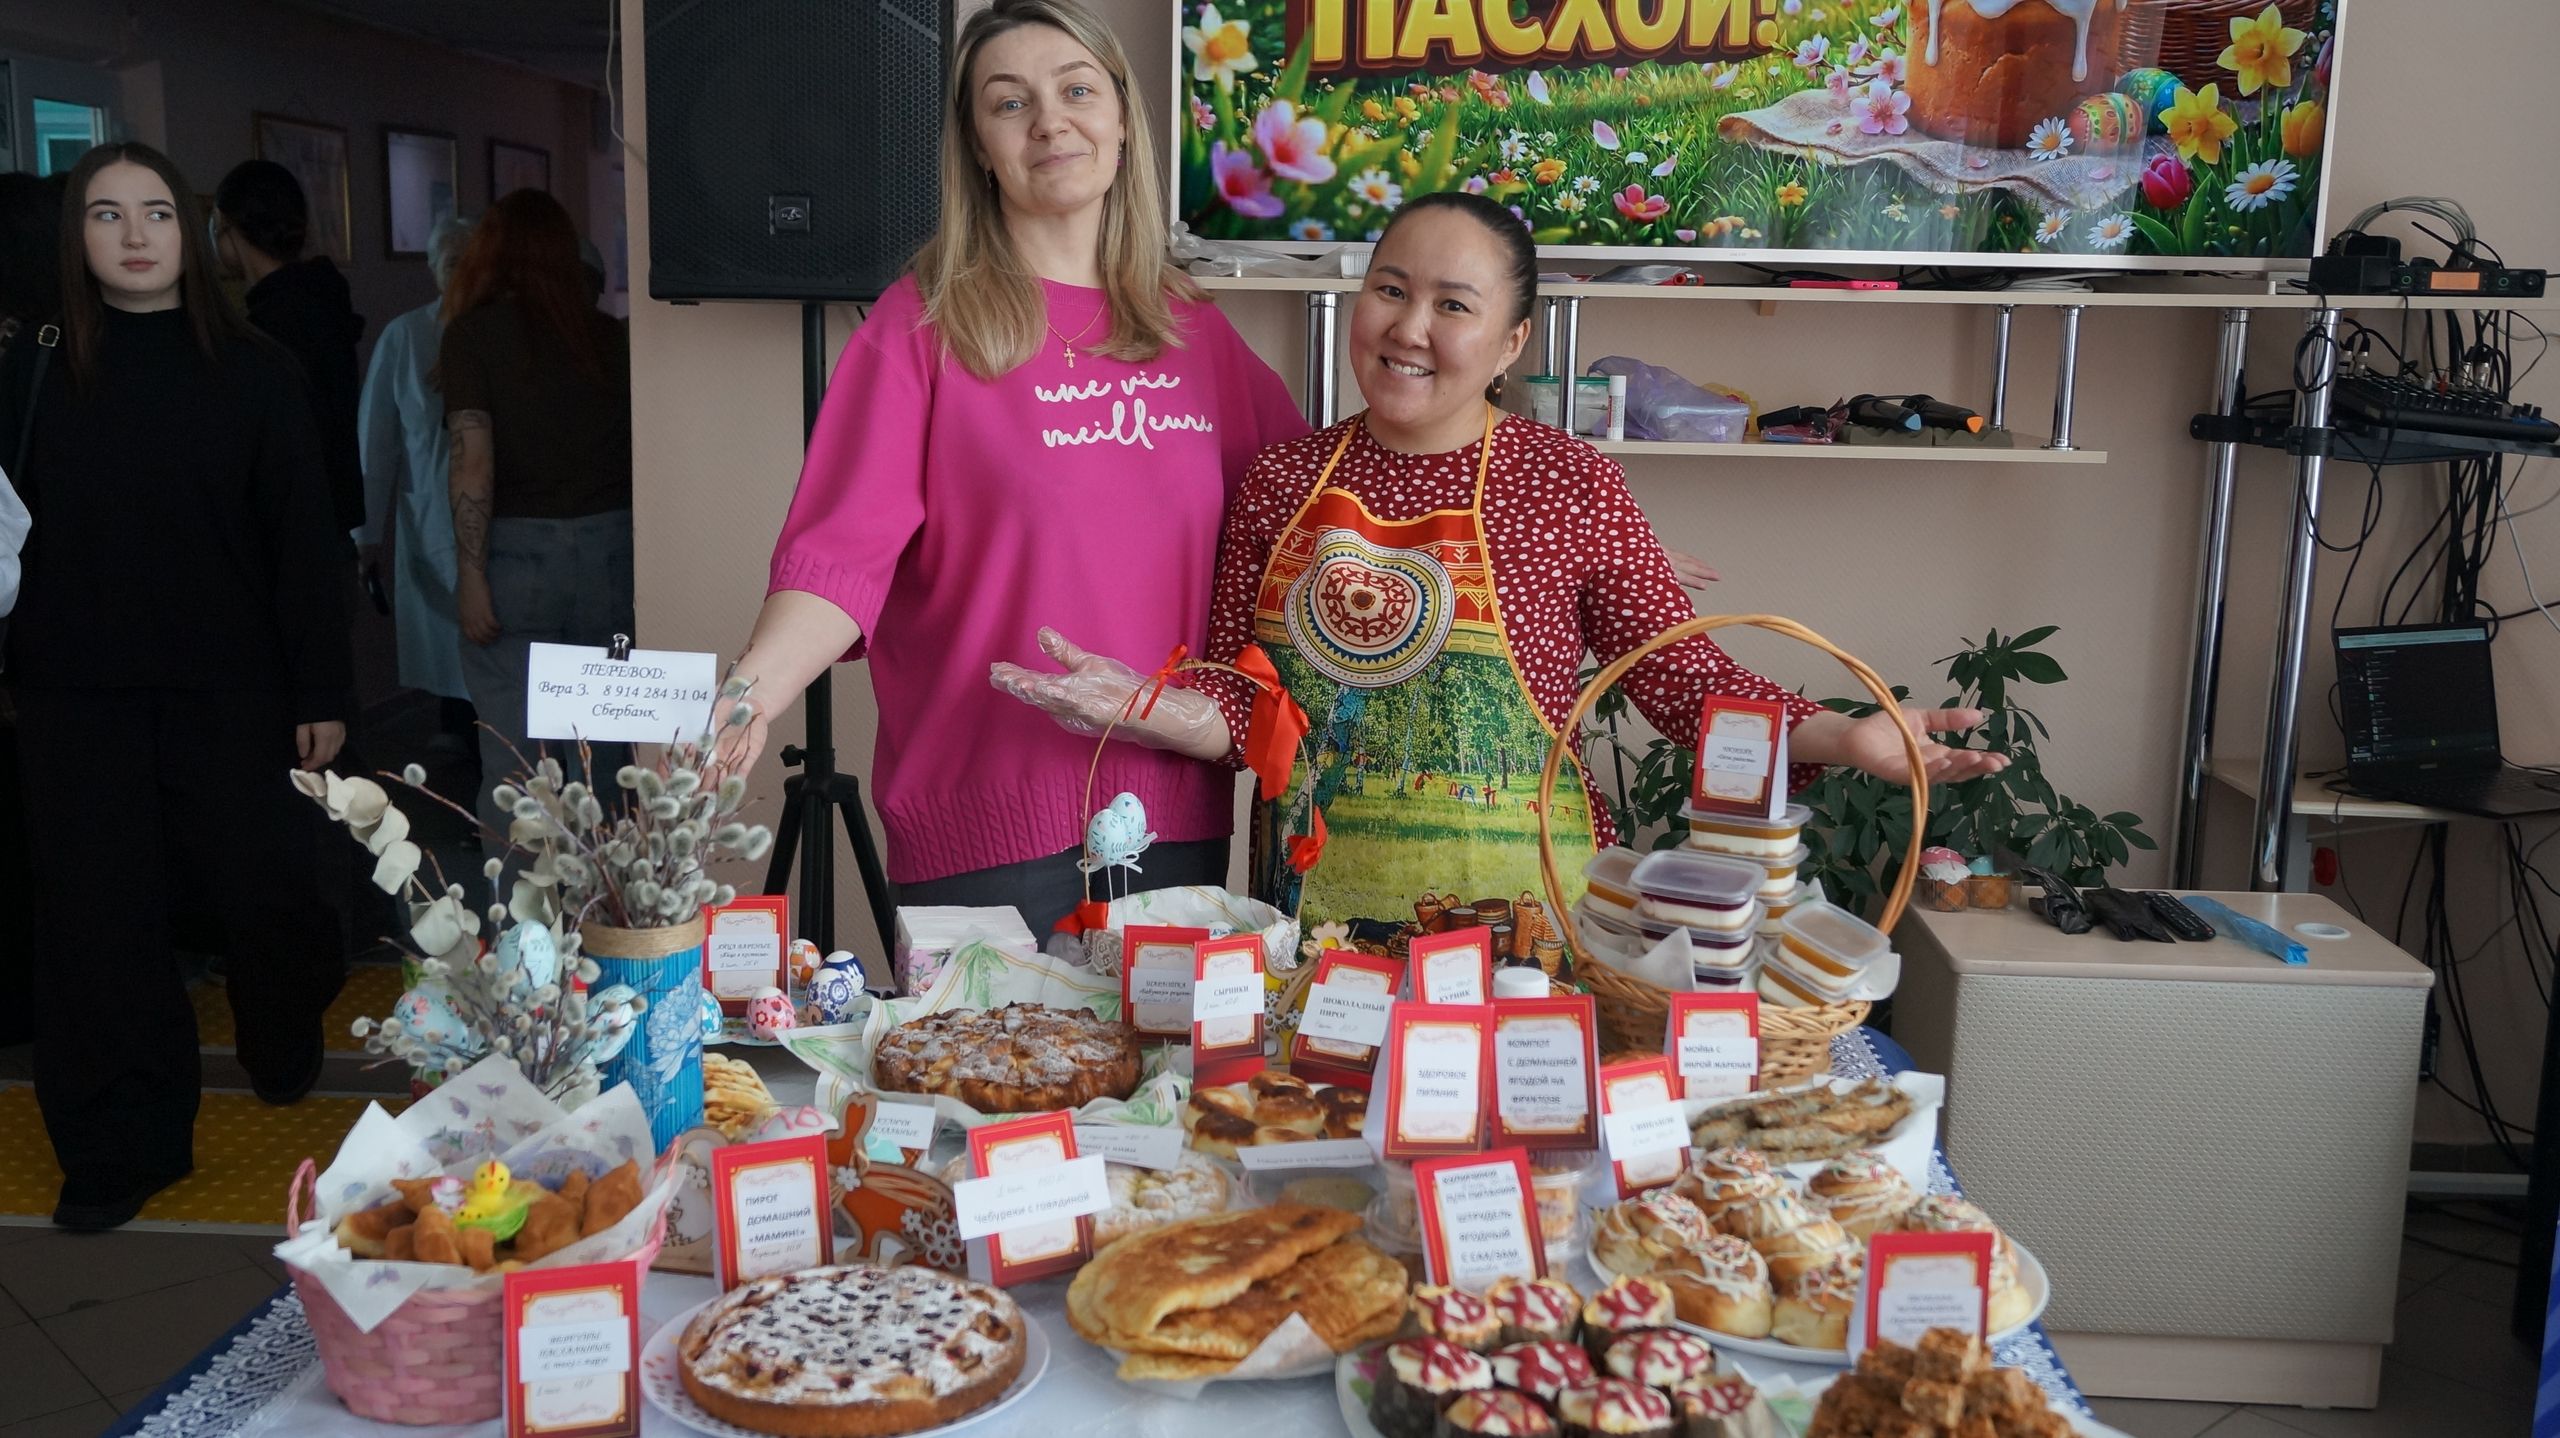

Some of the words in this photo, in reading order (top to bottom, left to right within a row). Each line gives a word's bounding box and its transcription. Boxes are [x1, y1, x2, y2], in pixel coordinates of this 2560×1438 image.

[1034, 379, 1112, 402] une
[1120, 370, 1181, 396] vie
[581, 663, 667, 680] ПЕРЕВОД:
[538, 681, 572, 698] Вера
[603, 686, 611, 696] 8
[615, 687, 639, 698] 914
[644, 687, 667, 700] 284
[671, 689, 687, 701] 31
[692, 690, 708, 701] 04
[592, 703, 660, 721] Сбербанк
[1213, 985, 1249, 997] СЫРНИКИ
[1322, 996, 1386, 1013] ШОКОЛАДНЫЙ
[1319, 1008, 1348, 1020] ПИРОГ
[745, 1193, 778, 1206] ПИРОГ
[746, 1206, 811, 1227] ДОМАШНИЙ
[974, 1207, 1026, 1226] Чебуреки
[1036, 1191, 1090, 1213] говядиной
